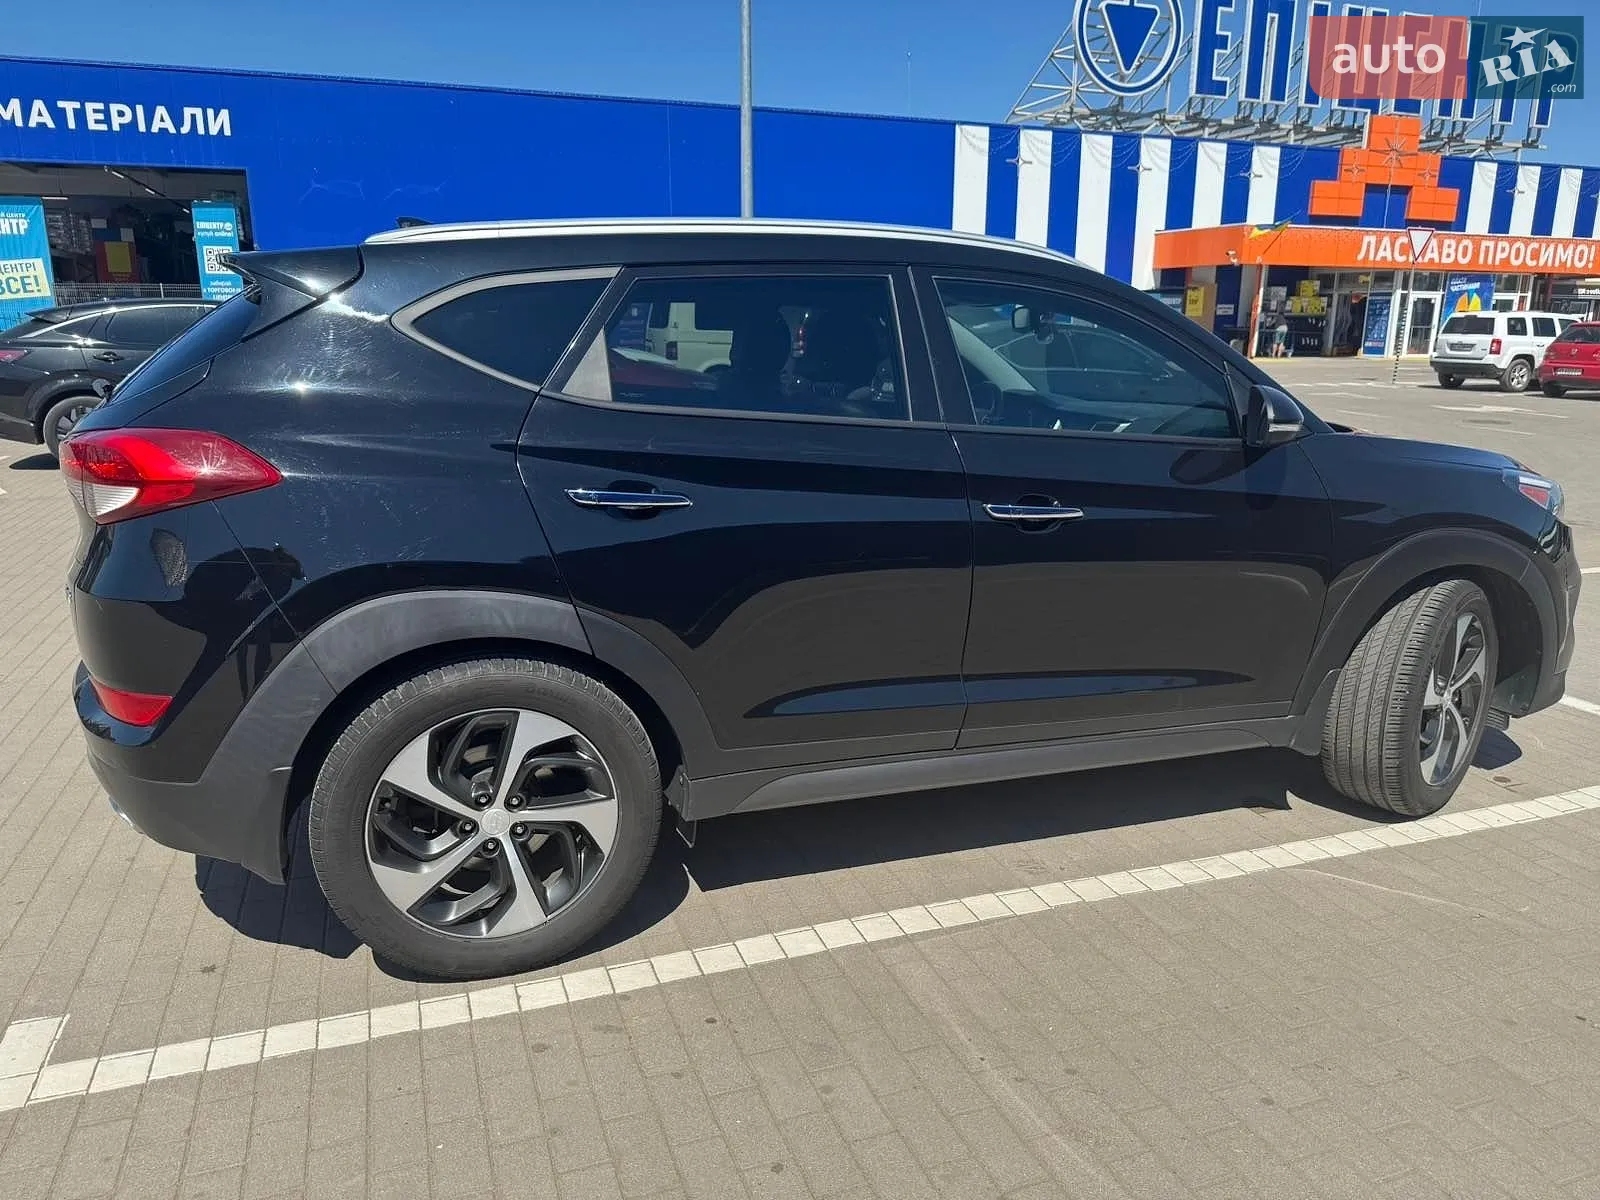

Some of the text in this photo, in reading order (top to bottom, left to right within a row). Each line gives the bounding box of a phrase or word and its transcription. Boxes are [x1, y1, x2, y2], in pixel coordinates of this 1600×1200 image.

[0, 97, 232, 136] МАТЕРІАЛИ
[0, 218, 29, 235] НТР
[1357, 235, 1596, 269] ЛАСАВО ПРОСИМО!
